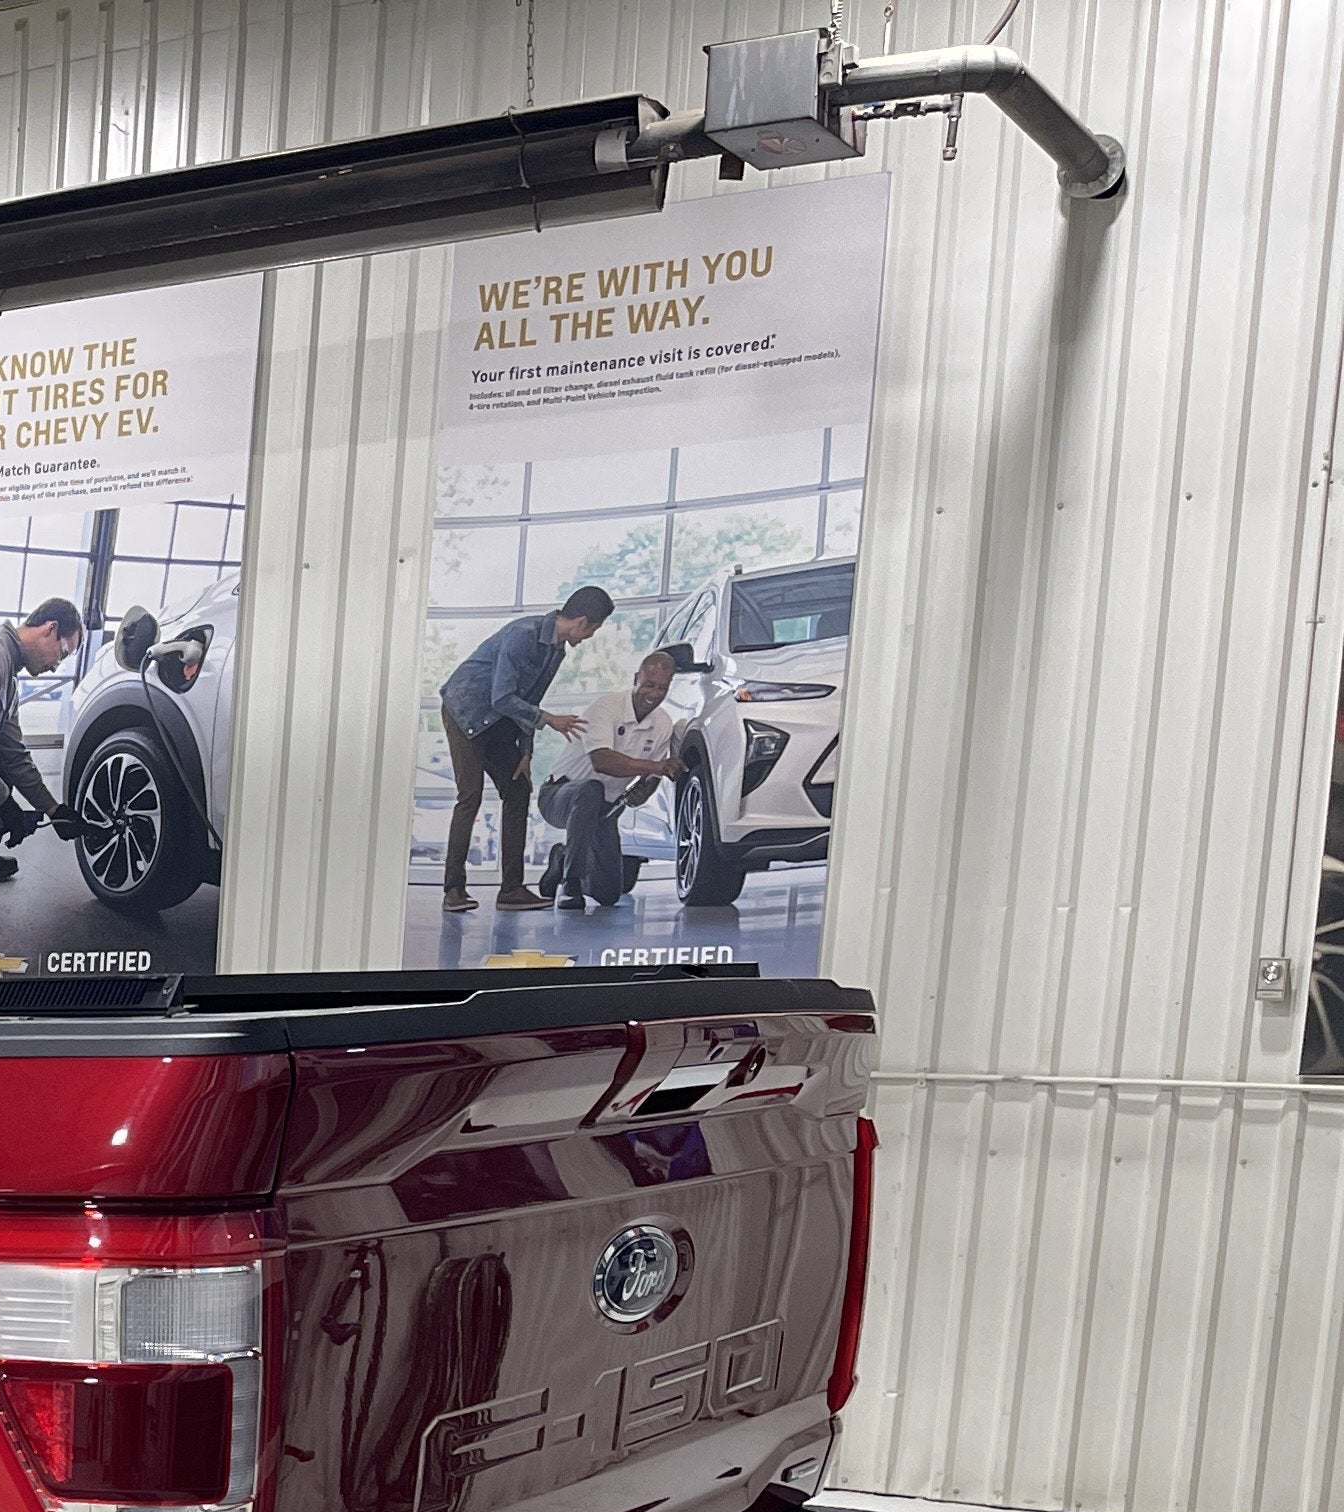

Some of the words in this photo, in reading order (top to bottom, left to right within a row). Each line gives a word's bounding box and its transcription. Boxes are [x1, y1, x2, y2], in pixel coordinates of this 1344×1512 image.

[479, 272, 585, 313] WE'RE
[597, 258, 689, 299] WITH
[701, 246, 773, 285] YOU
[474, 321, 537, 352] ALL
[550, 308, 616, 343] THE
[627, 296, 710, 335] WAY.
[83, 338, 137, 370] THE
[472, 370, 504, 383] Your
[510, 366, 541, 380] first
[546, 355, 645, 377] maintenance
[650, 349, 683, 364] visit
[688, 346, 700, 360] is
[27, 378, 104, 412] TIRES
[115, 369, 169, 402] FOR
[16, 412, 109, 448] CHEVY
[118, 407, 159, 436] EV.
[34, 458, 100, 474] Guarantee.
[47, 951, 150, 972] CERTIFIED
[622, 1247, 669, 1302] Ford
